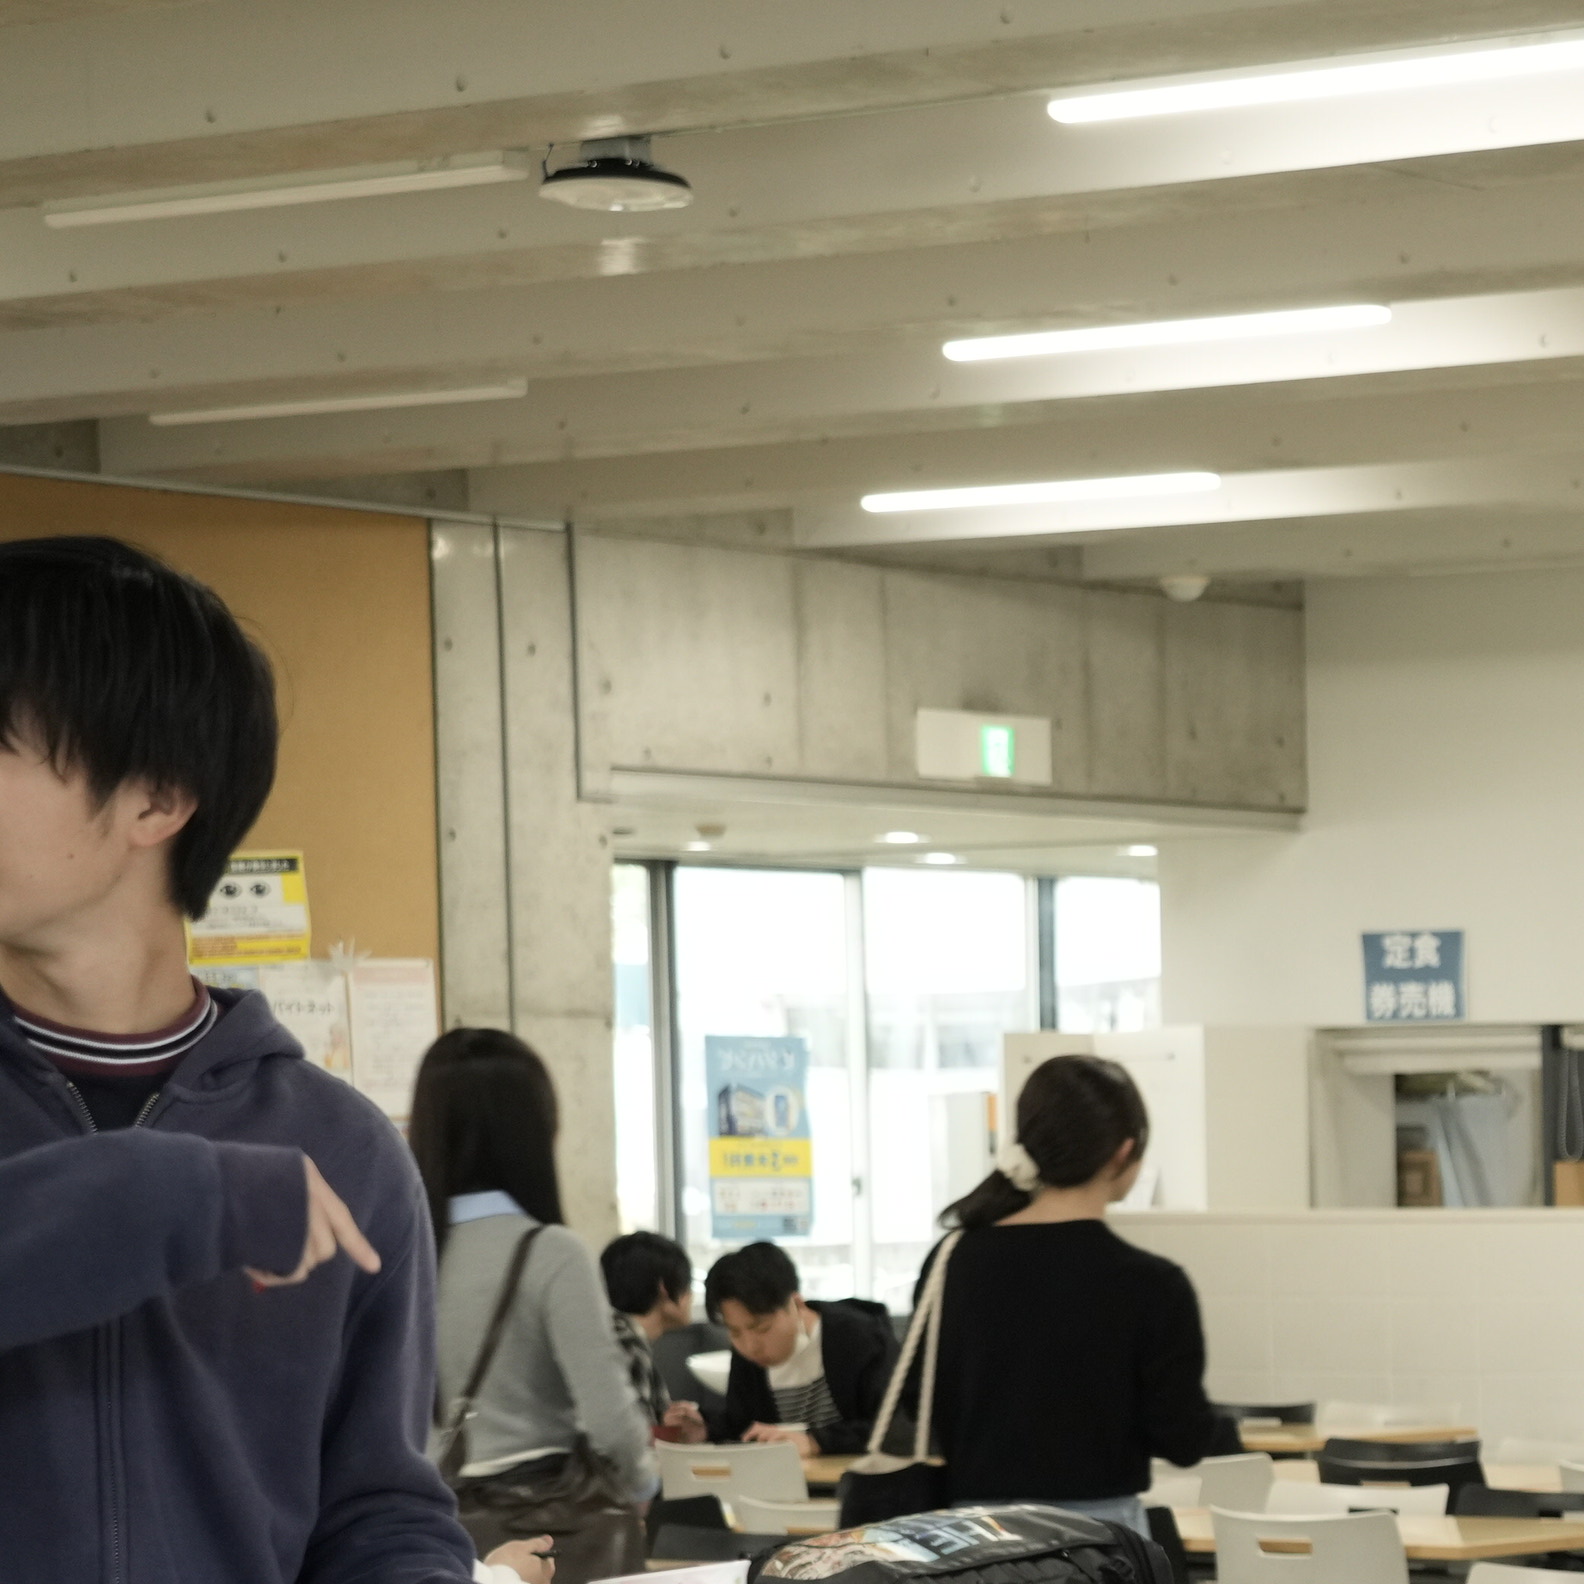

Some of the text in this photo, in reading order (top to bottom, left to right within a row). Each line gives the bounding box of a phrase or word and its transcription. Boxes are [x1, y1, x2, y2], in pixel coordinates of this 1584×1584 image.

[1382, 933, 1441, 969] 定食
[1370, 980, 1456, 1018] 券売機
